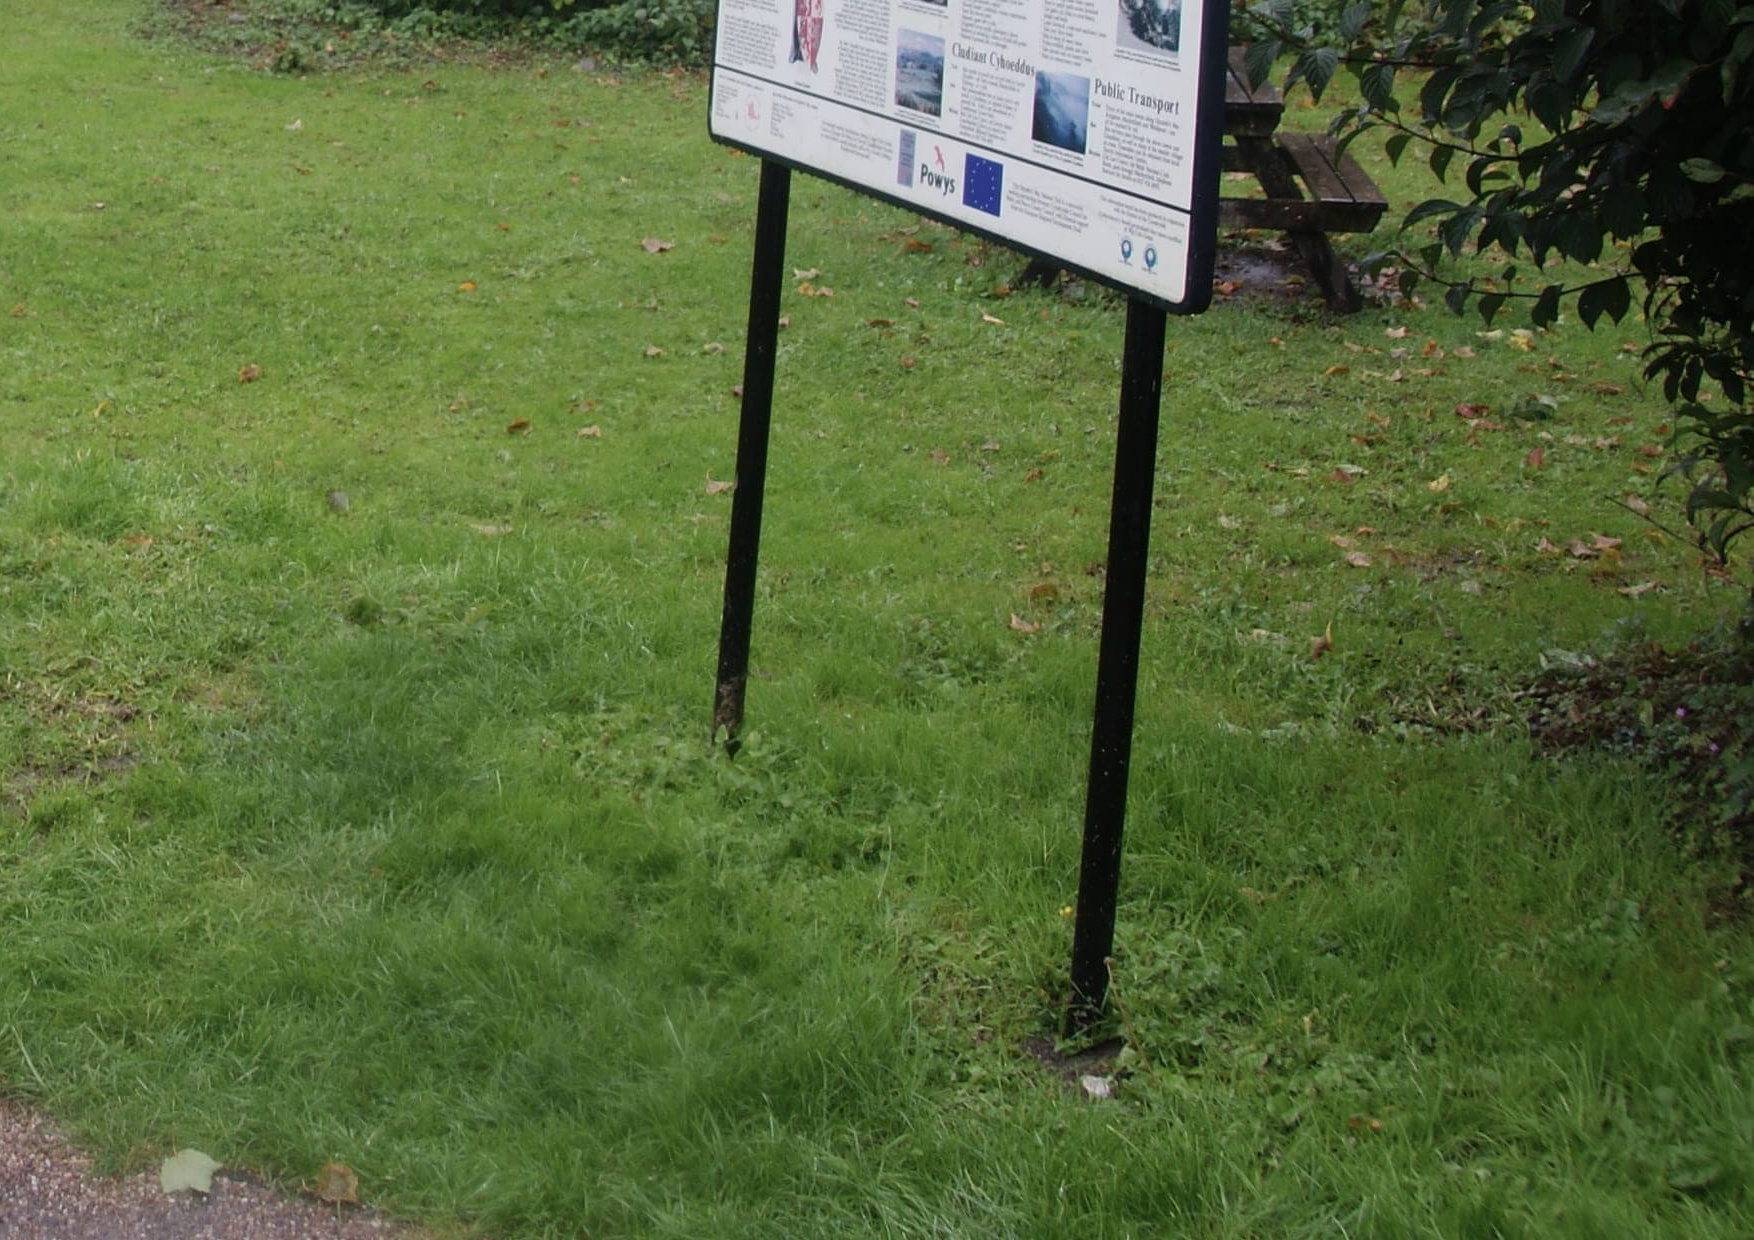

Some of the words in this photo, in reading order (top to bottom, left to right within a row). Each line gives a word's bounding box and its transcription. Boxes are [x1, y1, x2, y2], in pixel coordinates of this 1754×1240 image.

[952, 42, 987, 64] Cludiant
[989, 51, 1036, 77] Cyhoeddus
[1094, 77, 1126, 101] Public
[1128, 86, 1180, 116] Transport
[920, 163, 956, 196] Powys
